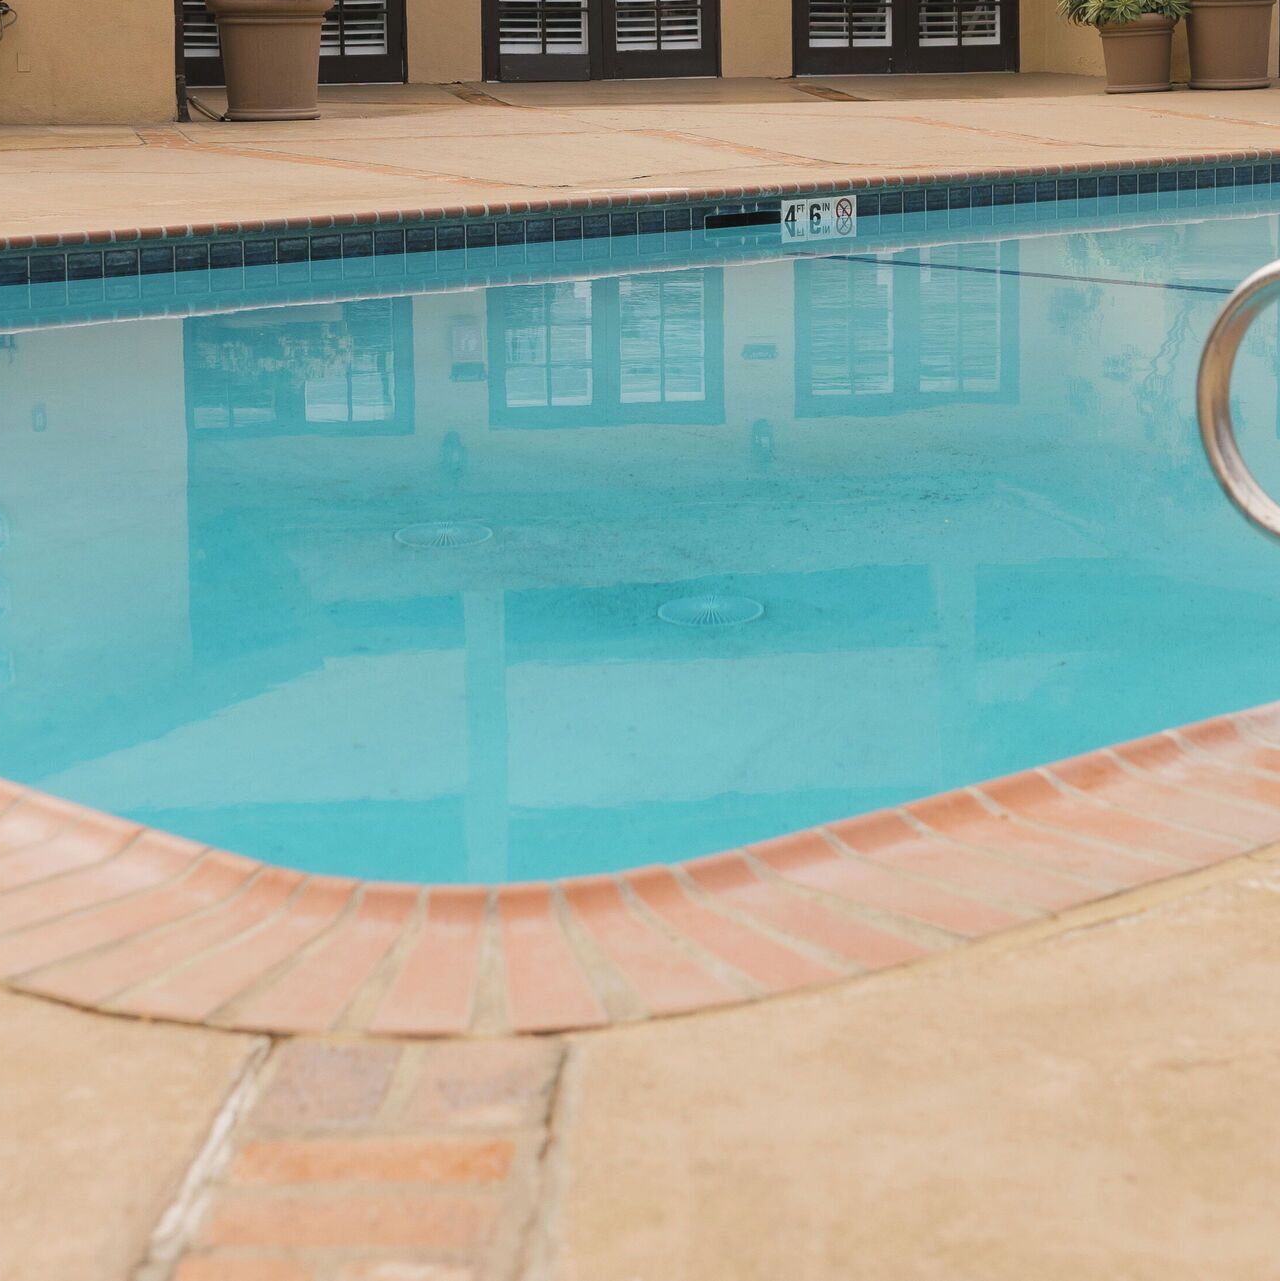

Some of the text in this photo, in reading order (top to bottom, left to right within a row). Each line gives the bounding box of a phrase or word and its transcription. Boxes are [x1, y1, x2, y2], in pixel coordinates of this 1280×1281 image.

[784, 202, 831, 222] 4 FT 6 IN
